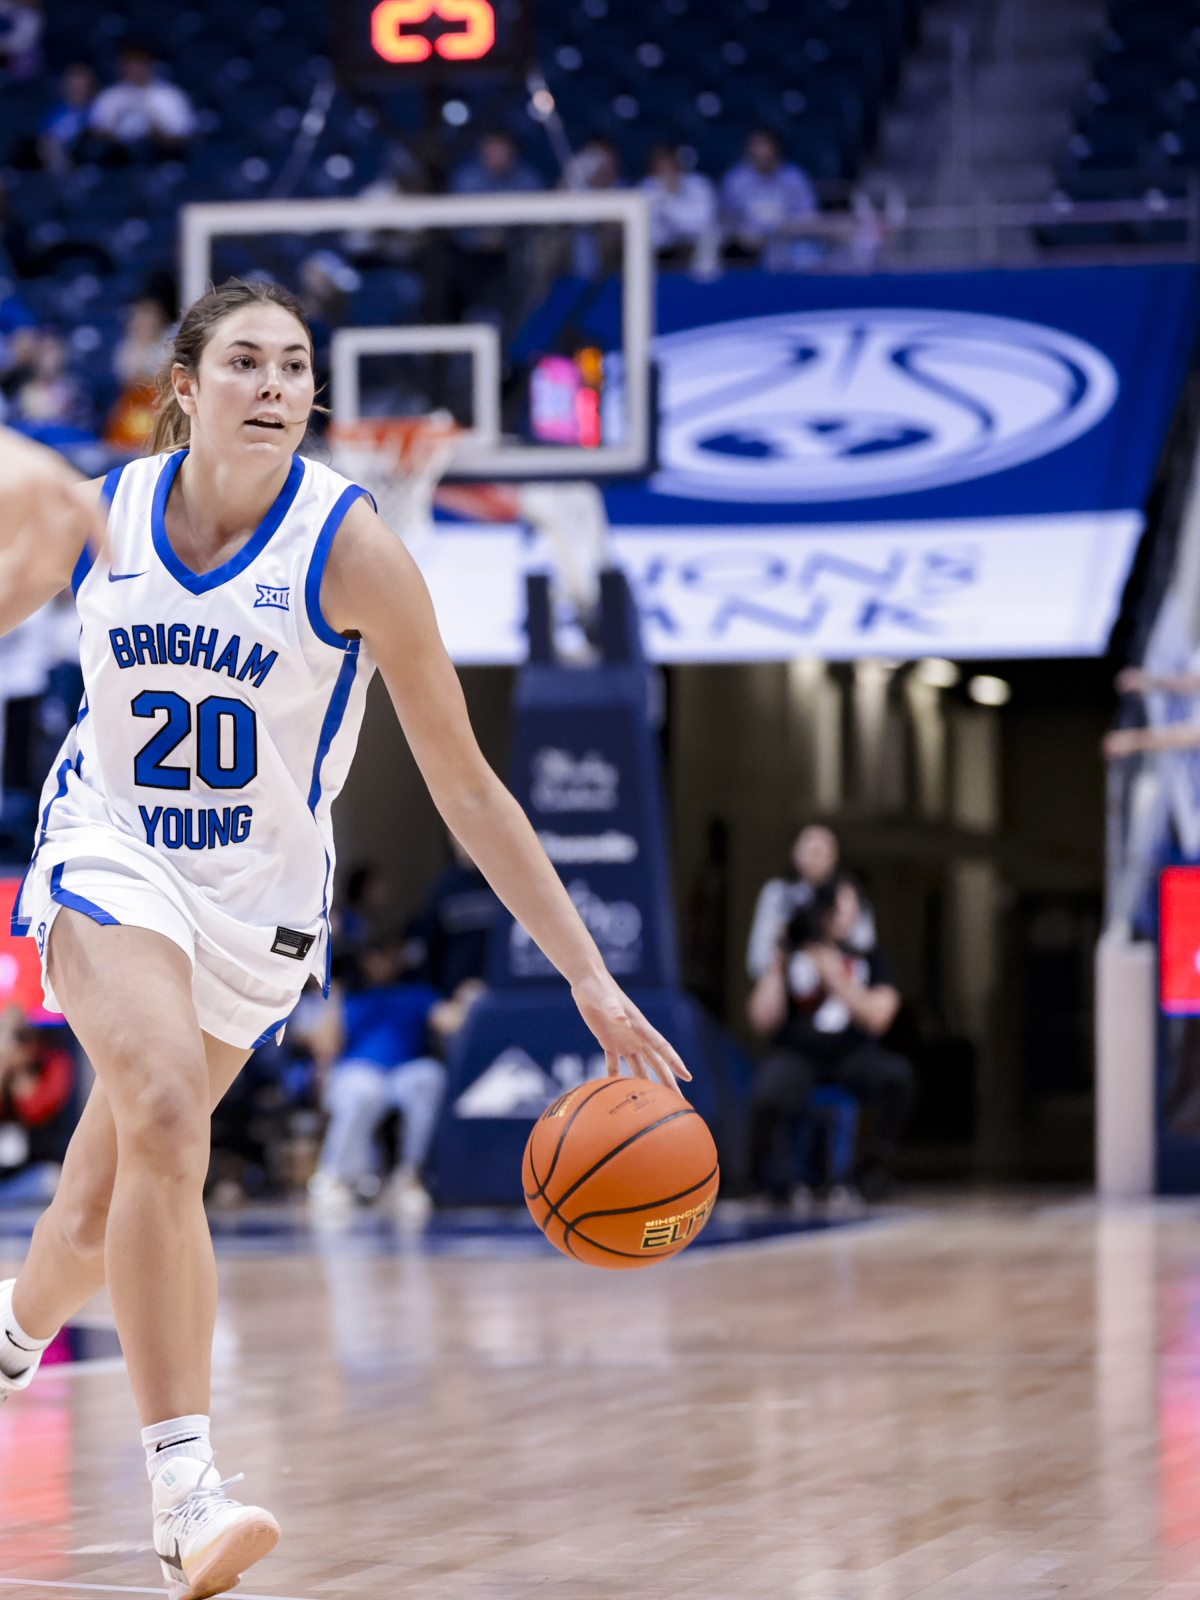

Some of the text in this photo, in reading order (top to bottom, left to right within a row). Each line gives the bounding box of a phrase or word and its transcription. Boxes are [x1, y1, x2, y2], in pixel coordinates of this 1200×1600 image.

[108, 623, 279, 688] BRIGHAM
[130, 689, 258, 790] 20
[138, 805, 253, 850] YOUNG
